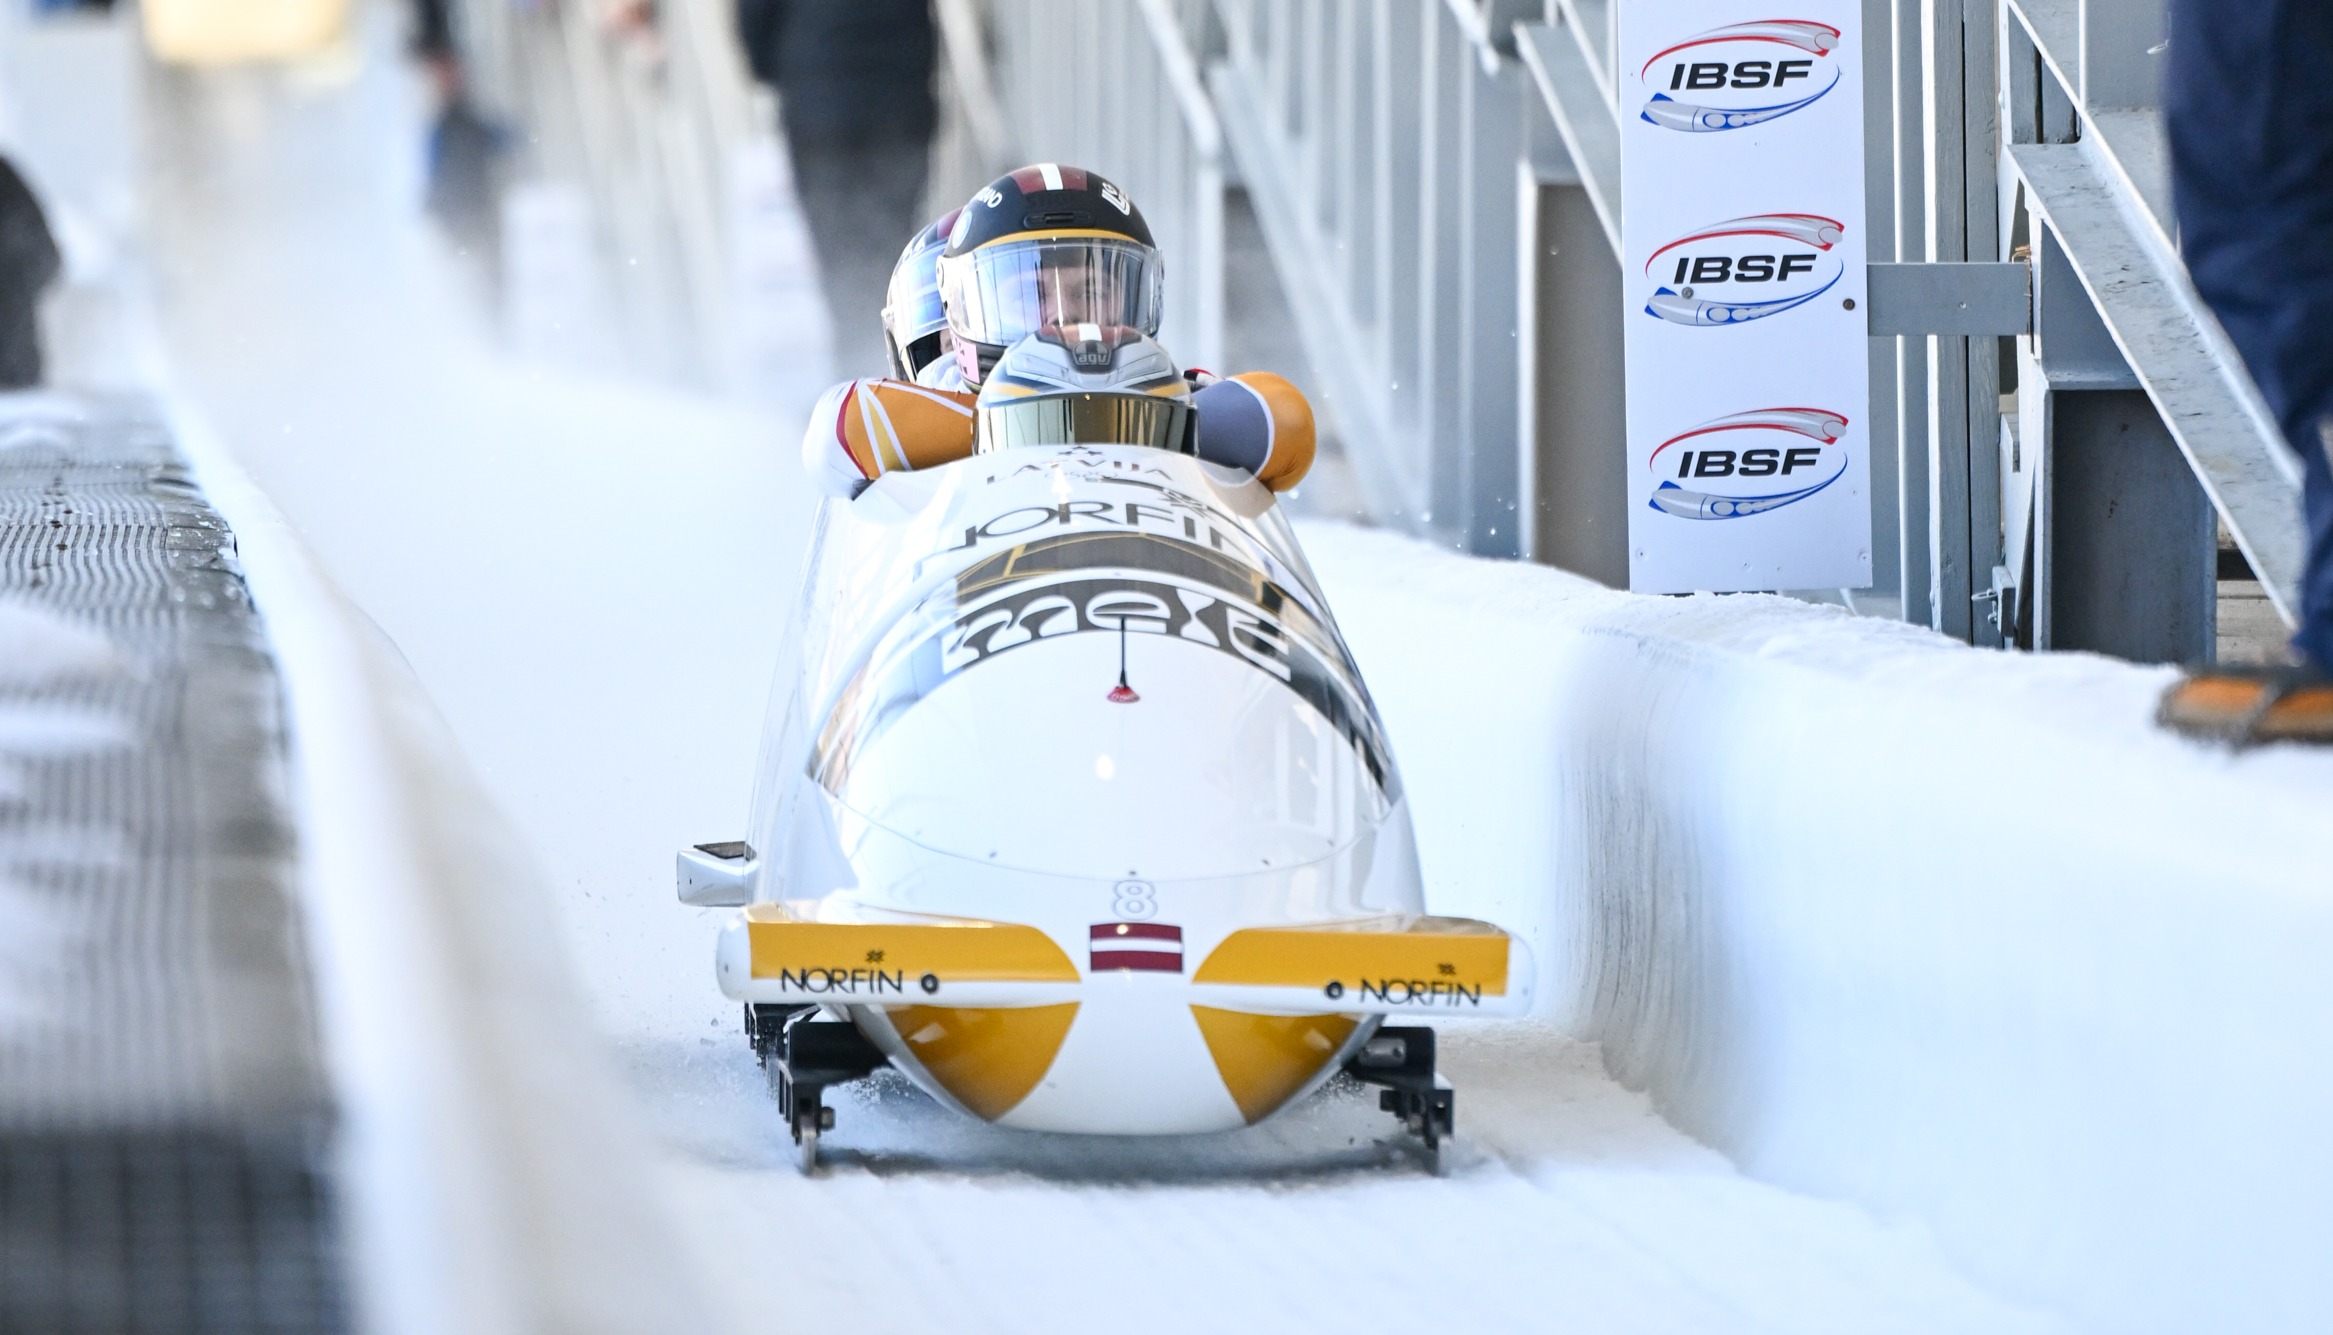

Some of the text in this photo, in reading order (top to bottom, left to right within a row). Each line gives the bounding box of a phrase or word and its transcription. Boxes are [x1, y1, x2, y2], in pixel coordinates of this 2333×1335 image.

[1669, 59, 1813, 91] IBSF
[1673, 253, 1817, 284] IBSF
[1677, 447, 1821, 479] IBSF
[1111, 879, 1159, 921] 8
[781, 967, 904, 995] NORFIN
[1359, 976, 1481, 1007] NORFIN
